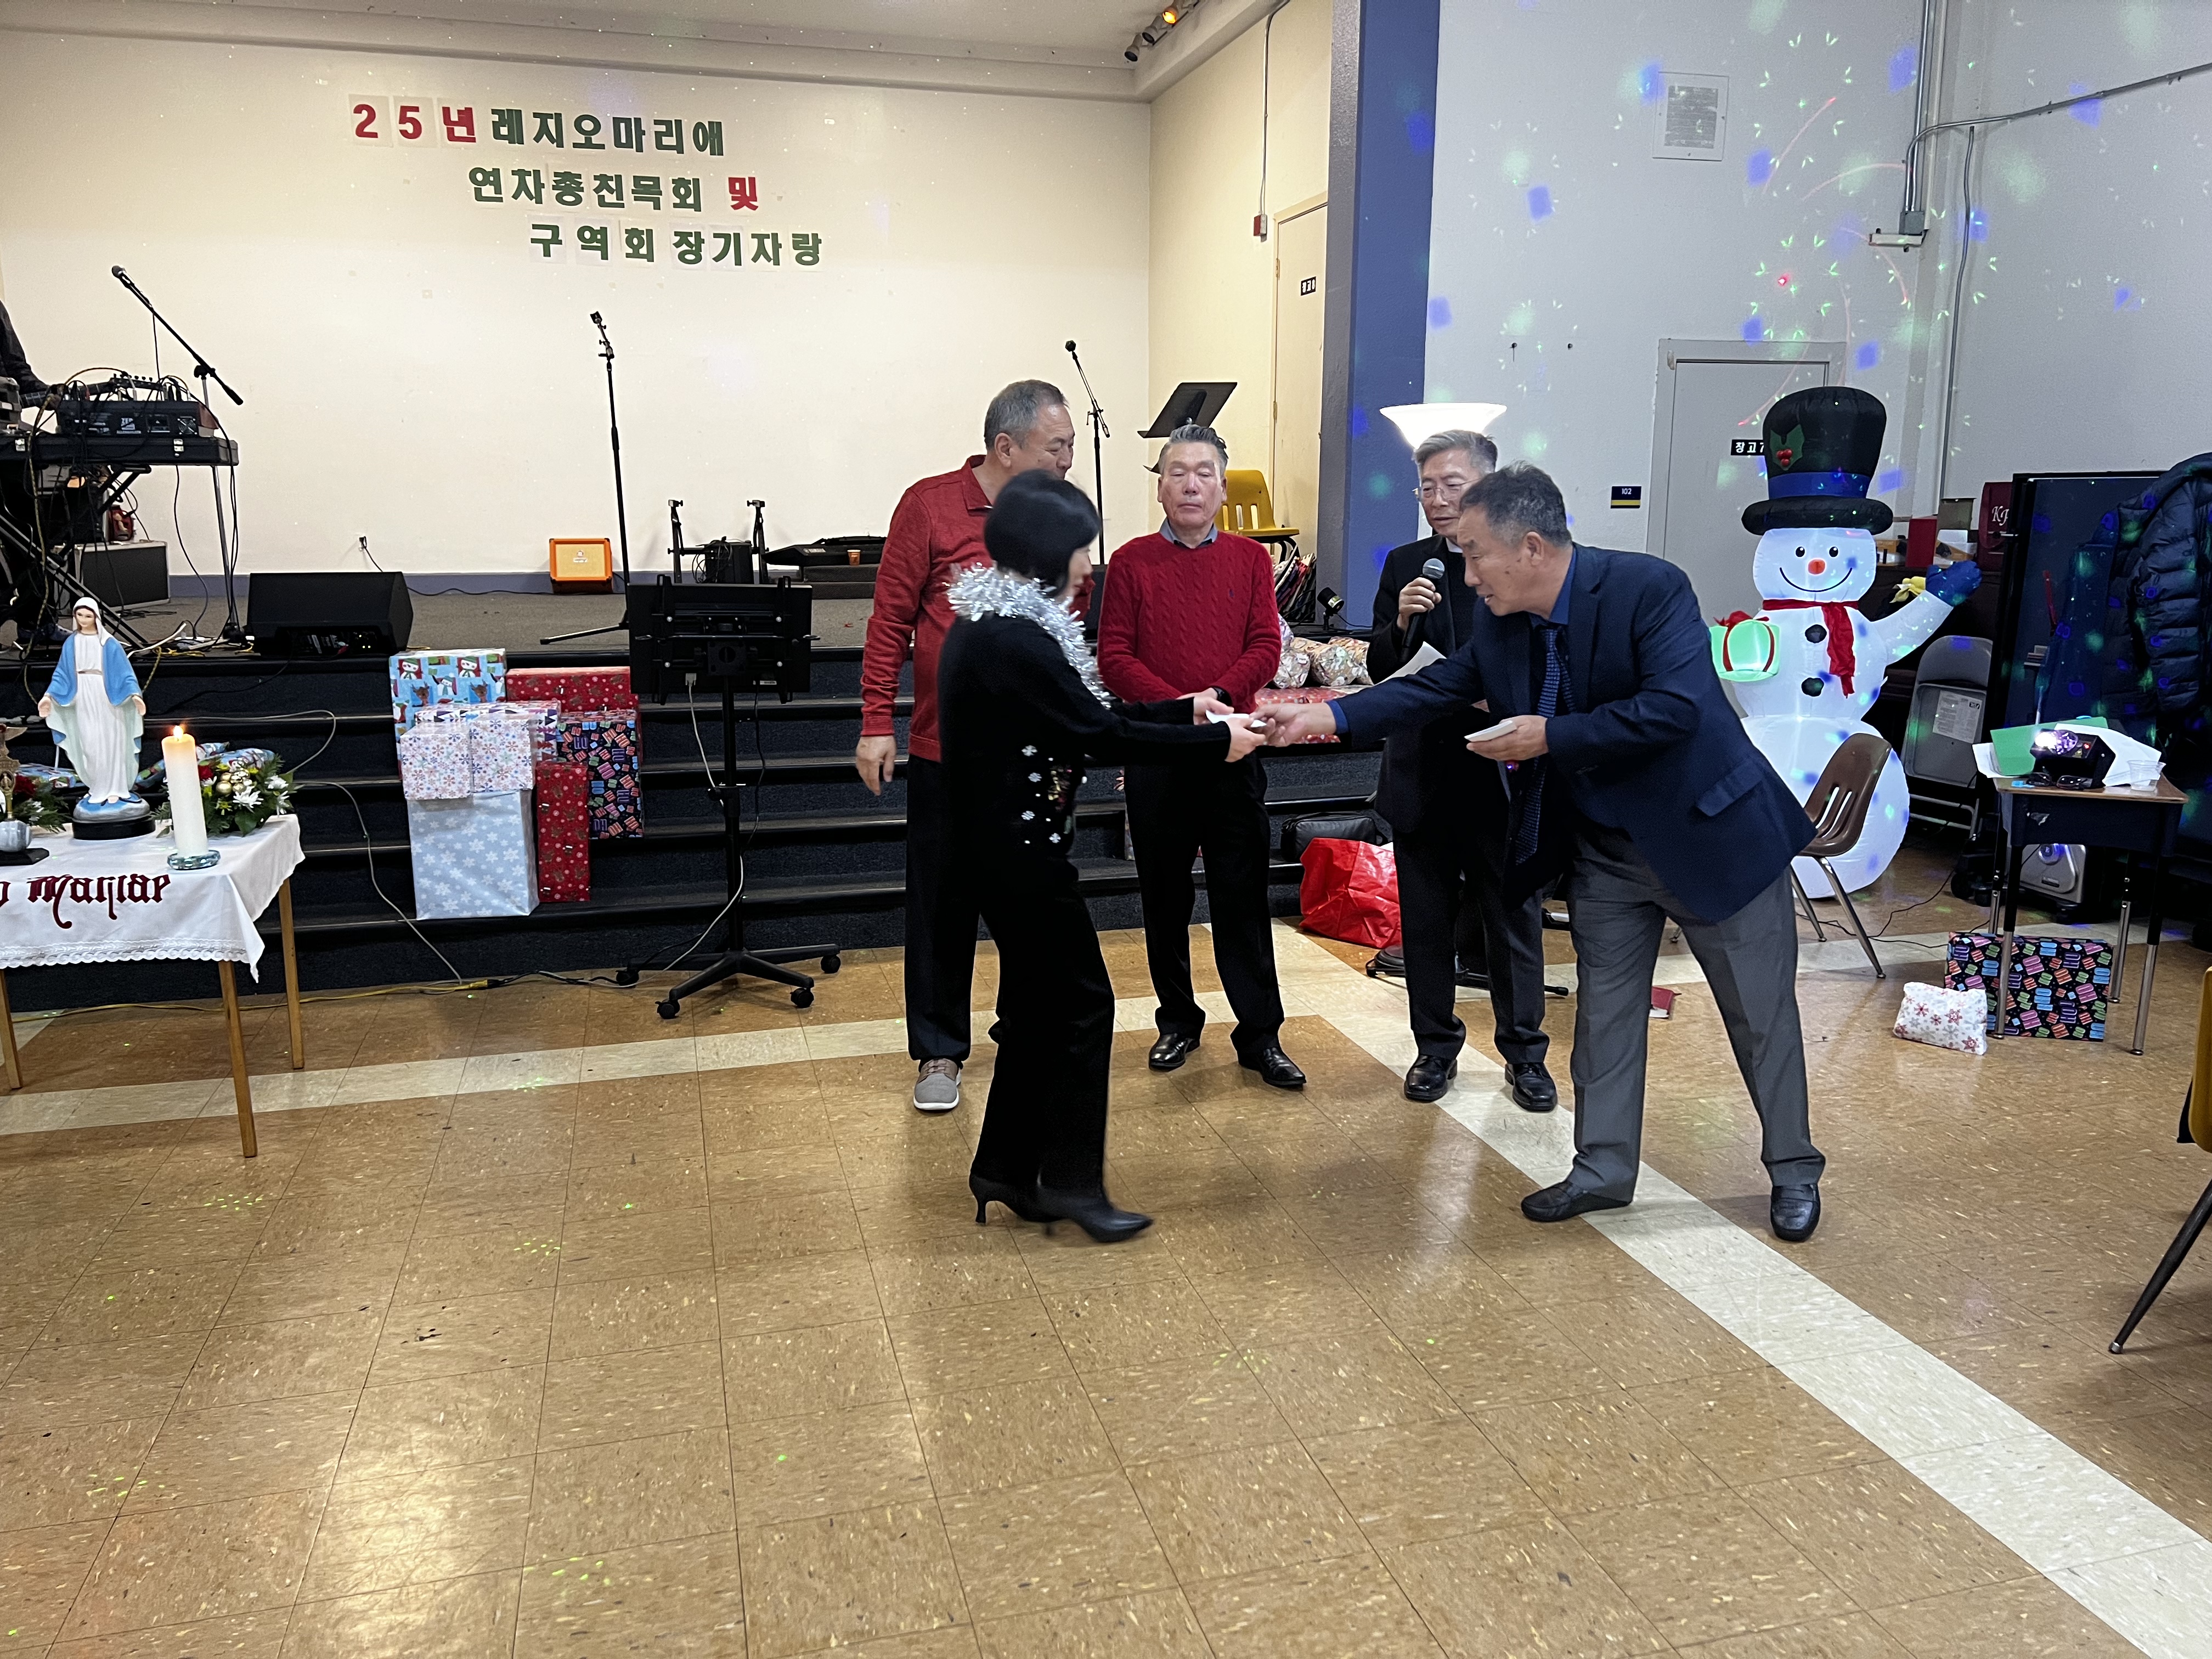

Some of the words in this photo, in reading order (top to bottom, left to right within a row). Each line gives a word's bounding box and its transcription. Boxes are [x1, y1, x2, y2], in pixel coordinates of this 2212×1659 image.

[354, 104, 476, 143] 25년
[490, 108, 724, 156] 레지오마리애
[469, 167, 702, 212] 연차총친목회
[728, 177, 759, 211] 및
[531, 224, 654, 262] 구역회
[672, 231, 822, 266] 장기자랑
